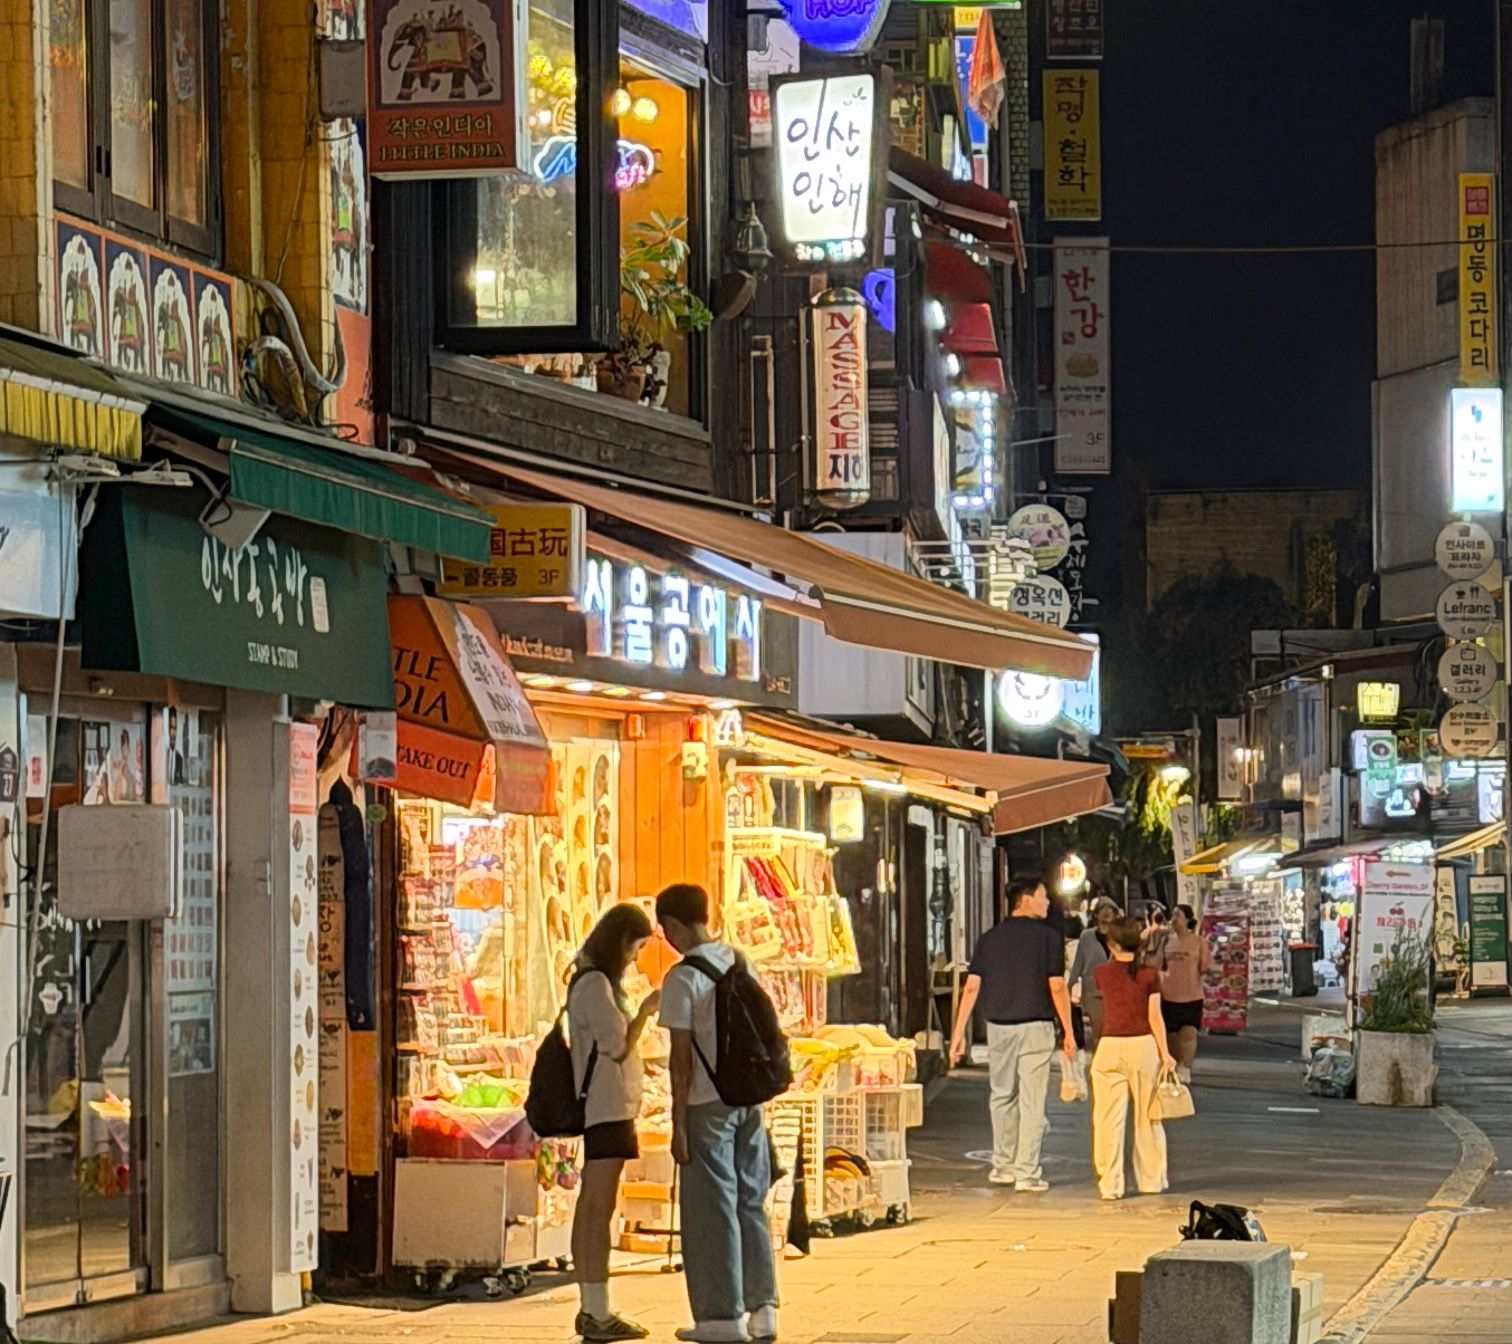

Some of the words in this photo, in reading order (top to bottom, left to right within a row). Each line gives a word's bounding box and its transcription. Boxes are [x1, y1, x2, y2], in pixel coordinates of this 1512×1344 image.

[380, 143, 443, 161] LITTLE
[451, 141, 504, 159] INDIA
[1467, 222, 1486, 283] 명동
[1061, 266, 1104, 338] 한강
[1468, 291, 1491, 370] 코다리
[538, 569, 560, 586] 3F
[1444, 601, 1492, 615] Lefranc
[1450, 663, 1487, 677] 갤러리
[436, 756, 472, 779] OUT
